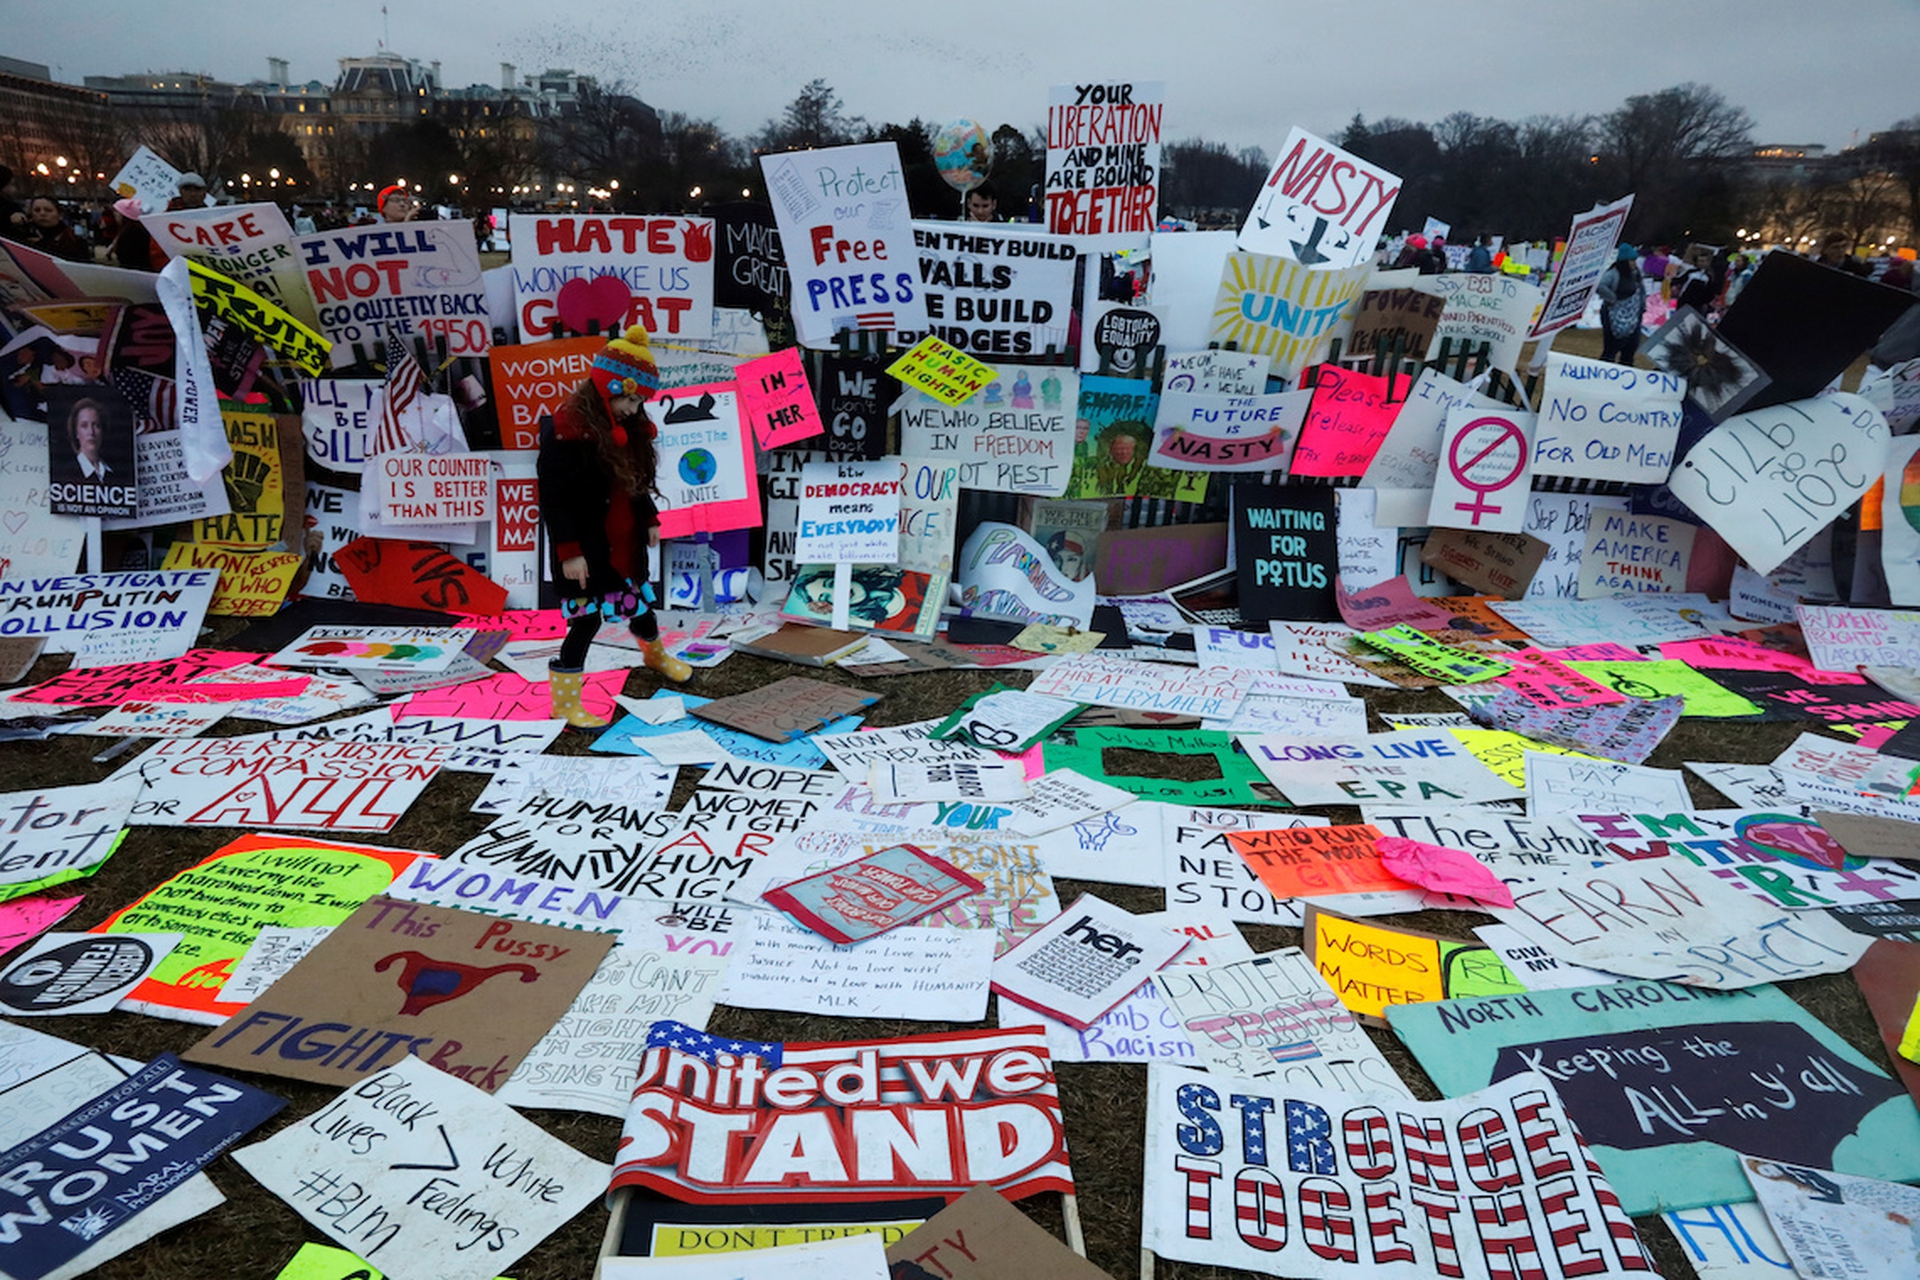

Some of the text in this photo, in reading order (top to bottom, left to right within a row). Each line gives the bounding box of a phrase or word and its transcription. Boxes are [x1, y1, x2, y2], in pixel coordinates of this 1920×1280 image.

[1075, 83, 1134, 106] YOUR
[1048, 104, 1163, 150] LIBERATION
[1062, 146, 1101, 168] AND
[815, 166, 900, 197] Protect
[1046, 165, 1154, 188] ARE BOUND
[1267, 138, 1400, 237] NASTY
[833, 203, 865, 220] our
[1045, 185, 1157, 235] TOGETHER
[168, 213, 265, 246] CARE
[536, 218, 676, 255] HATE
[206, 245, 241, 256] IS
[301, 230, 437, 265] I WILL
[809, 225, 887, 266] Free
[943, 233, 1076, 260] THEY BUILD
[307, 260, 408, 305] NOT
[659, 266, 689, 291] US
[807, 272, 914, 312] PRESS
[1362, 290, 1443, 318] POWER
[319, 294, 489, 327] GO QUIETLY BACK
[956, 297, 1053, 324] BUILD
[1241, 292, 1351, 338] UNITE
[326, 326, 361, 344] TO
[1102, 329, 1155, 348] EQUALITY
[501, 353, 598, 377] WOMEN
[911, 350, 982, 392] HUMAN
[927, 341, 988, 379] BASIC
[838, 370, 877, 399] WE
[901, 363, 968, 403] RIGHTS!
[1192, 407, 1283, 422] FUTURE
[1227, 398, 1255, 407] THE
[335, 411, 367, 428] BE
[767, 404, 805, 430] HER
[831, 412, 867, 440] GO
[904, 409, 1065, 433] WE WHO BELIEVE
[1599, 401, 1682, 429] COUNTRY
[1226, 425, 1240, 434] IS
[828, 438, 866, 450] back
[931, 434, 1054, 459] IN FREEDOM
[1170, 437, 1274, 459] NASTY
[1534, 437, 1672, 468] FOR OLD MEN
[385, 458, 489, 477] OUR COUNTRY
[838, 465, 864, 479] btw
[997, 463, 1059, 490] REST
[50, 483, 137, 505] SCIENCE
[391, 480, 488, 498] IS BETTER
[501, 484, 534, 501] WE
[681, 485, 720, 504] UNITE
[805, 481, 899, 498] DEMOCRACY
[67, 505, 82, 513] NOT
[98, 506, 130, 515] OPINION
[389, 500, 484, 519] THAN THIS
[829, 503, 874, 514] means
[1045, 508, 1090, 520] WE THE
[1247, 508, 1325, 531] WAITING
[201, 513, 282, 542] HATE
[1043, 516, 1094, 527] PEOPLE
[1605, 516, 1669, 543] MAKE
[1270, 535, 1307, 557] FOR
[1591, 538, 1682, 571] AMERICA
[250, 554, 301, 577] RESPECT
[970, 528, 1075, 602] PLANNED
[1606, 561, 1664, 583] THINK
[239, 577, 282, 594] WHO
[1804, 628, 1882, 646] RIGHTS
[1050, 668, 1248, 700] THREAT JUSTICE
[120, 702, 155, 714] WE
[1071, 683, 1229, 716] EVERYWHERE
[134, 709, 189, 723] are
[165, 718, 212, 727] THE
[98, 724, 191, 735] PEOPLE
[824, 734, 888, 750] NOW
[1259, 739, 1455, 762] LONG LIVE
[170, 756, 441, 782] COMPASSION
[1343, 765, 1406, 775] THE
[1568, 766, 1624, 786] PAY
[184, 772, 401, 830] ALL
[1337, 779, 1464, 800] EPA
[518, 796, 681, 838] HUMANS
[932, 801, 1013, 831] YOUR
[1189, 810, 1263, 830] NOT
[1579, 813, 1707, 838] I'M
[1231, 827, 1377, 848] WHO RUN
[1374, 816, 1501, 850] The
[1245, 850, 1314, 867] THE
[1476, 852, 1570, 868] OF THE
[1605, 839, 1780, 866] WITH
[203, 861, 325, 889] have my life
[260, 853, 363, 878] will not
[175, 873, 266, 894] narrowed
[408, 862, 624, 920] WOMEN
[861, 867, 937, 902] OUR POWER
[155, 887, 285, 913] not to
[671, 903, 734, 921] WILL
[867, 891, 895, 910] OUR
[1514, 868, 1705, 946] EARN
[365, 898, 442, 939] This
[687, 920, 732, 933] BE
[863, 910, 894, 925] OUR
[474, 920, 571, 963] Pussy
[883, 946, 914, 959] Love
[1321, 928, 1429, 973] WORDS
[811, 958, 896, 973] Not Love
[1525, 958, 1559, 973] MY
[912, 980, 986, 992] HUMANITY
[625, 995, 692, 1016] MY
[817, 994, 859, 1007] MLK
[1185, 991, 1356, 1046] TRANS
[1437, 995, 1544, 1034] NORTH
[1516, 1035, 1741, 1081] Keeping the
[142, 1061, 171, 1083] ALL
[902, 1047, 1049, 1103] we
[355, 1071, 439, 1134] Black
[1721, 1098, 1768, 1121] in
[309, 1100, 390, 1155] Lives
[618, 1094, 1064, 1188] STAND
[114, 1160, 189, 1203] NARAL
[481, 1141, 564, 1205] White
[292, 1168, 402, 1258] #BLM
[406, 1176, 521, 1253] Feelings
[678, 1227, 788, 1250] DON'T
